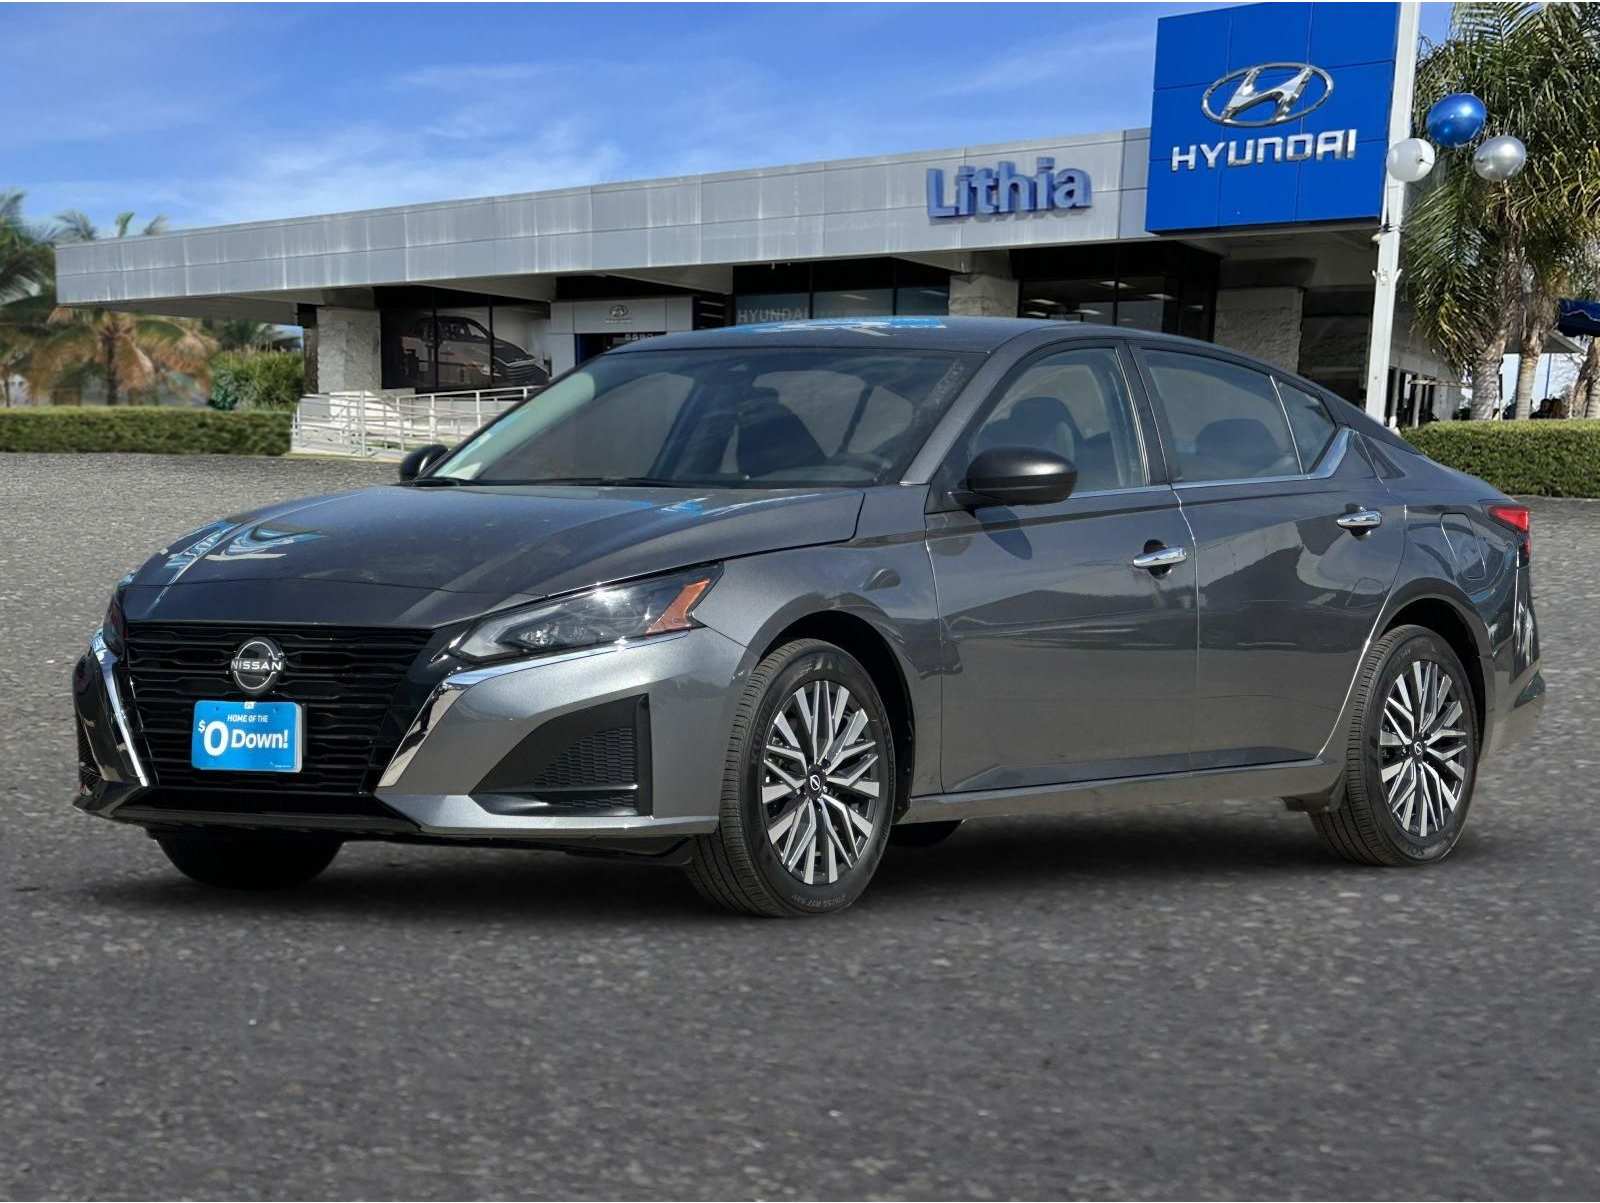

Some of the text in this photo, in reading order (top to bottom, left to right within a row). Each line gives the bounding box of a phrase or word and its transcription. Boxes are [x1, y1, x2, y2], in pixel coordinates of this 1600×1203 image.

[1171, 129, 1357, 172] HYUNDAI
[926, 157, 1092, 218] Lithia
[737, 307, 809, 323] HYUNDAI
[231, 660, 282, 671] NISSAN
[227, 714, 269, 723] HOME OF THE
[231, 729, 288, 749] Down!
